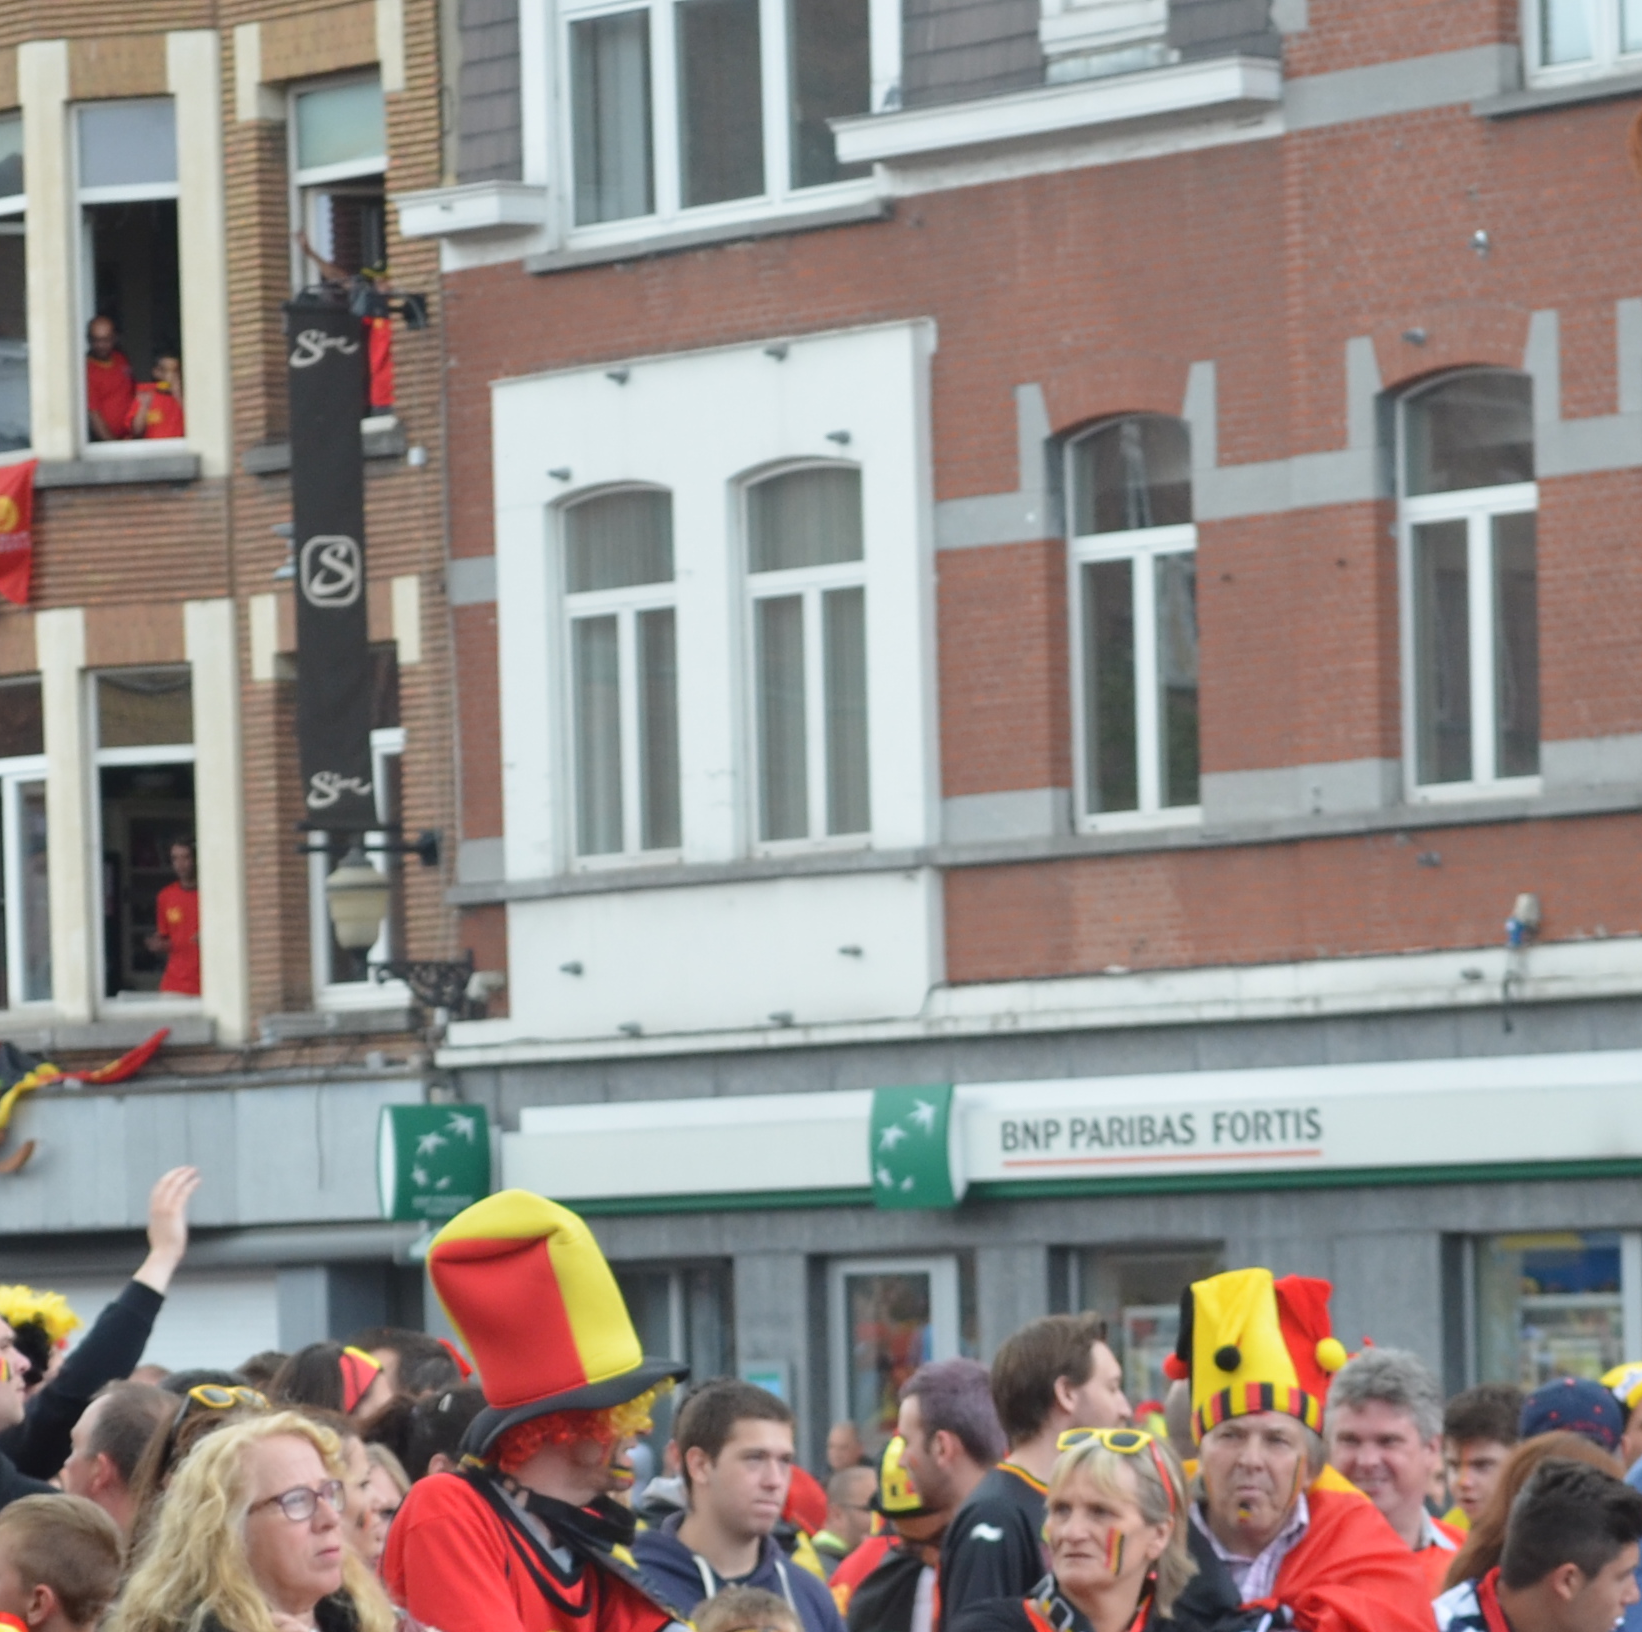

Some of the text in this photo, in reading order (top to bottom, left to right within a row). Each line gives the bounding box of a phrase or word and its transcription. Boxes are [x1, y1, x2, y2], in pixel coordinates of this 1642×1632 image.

[1001, 1107, 1322, 1151] BNP PARIBAS FORTIS
